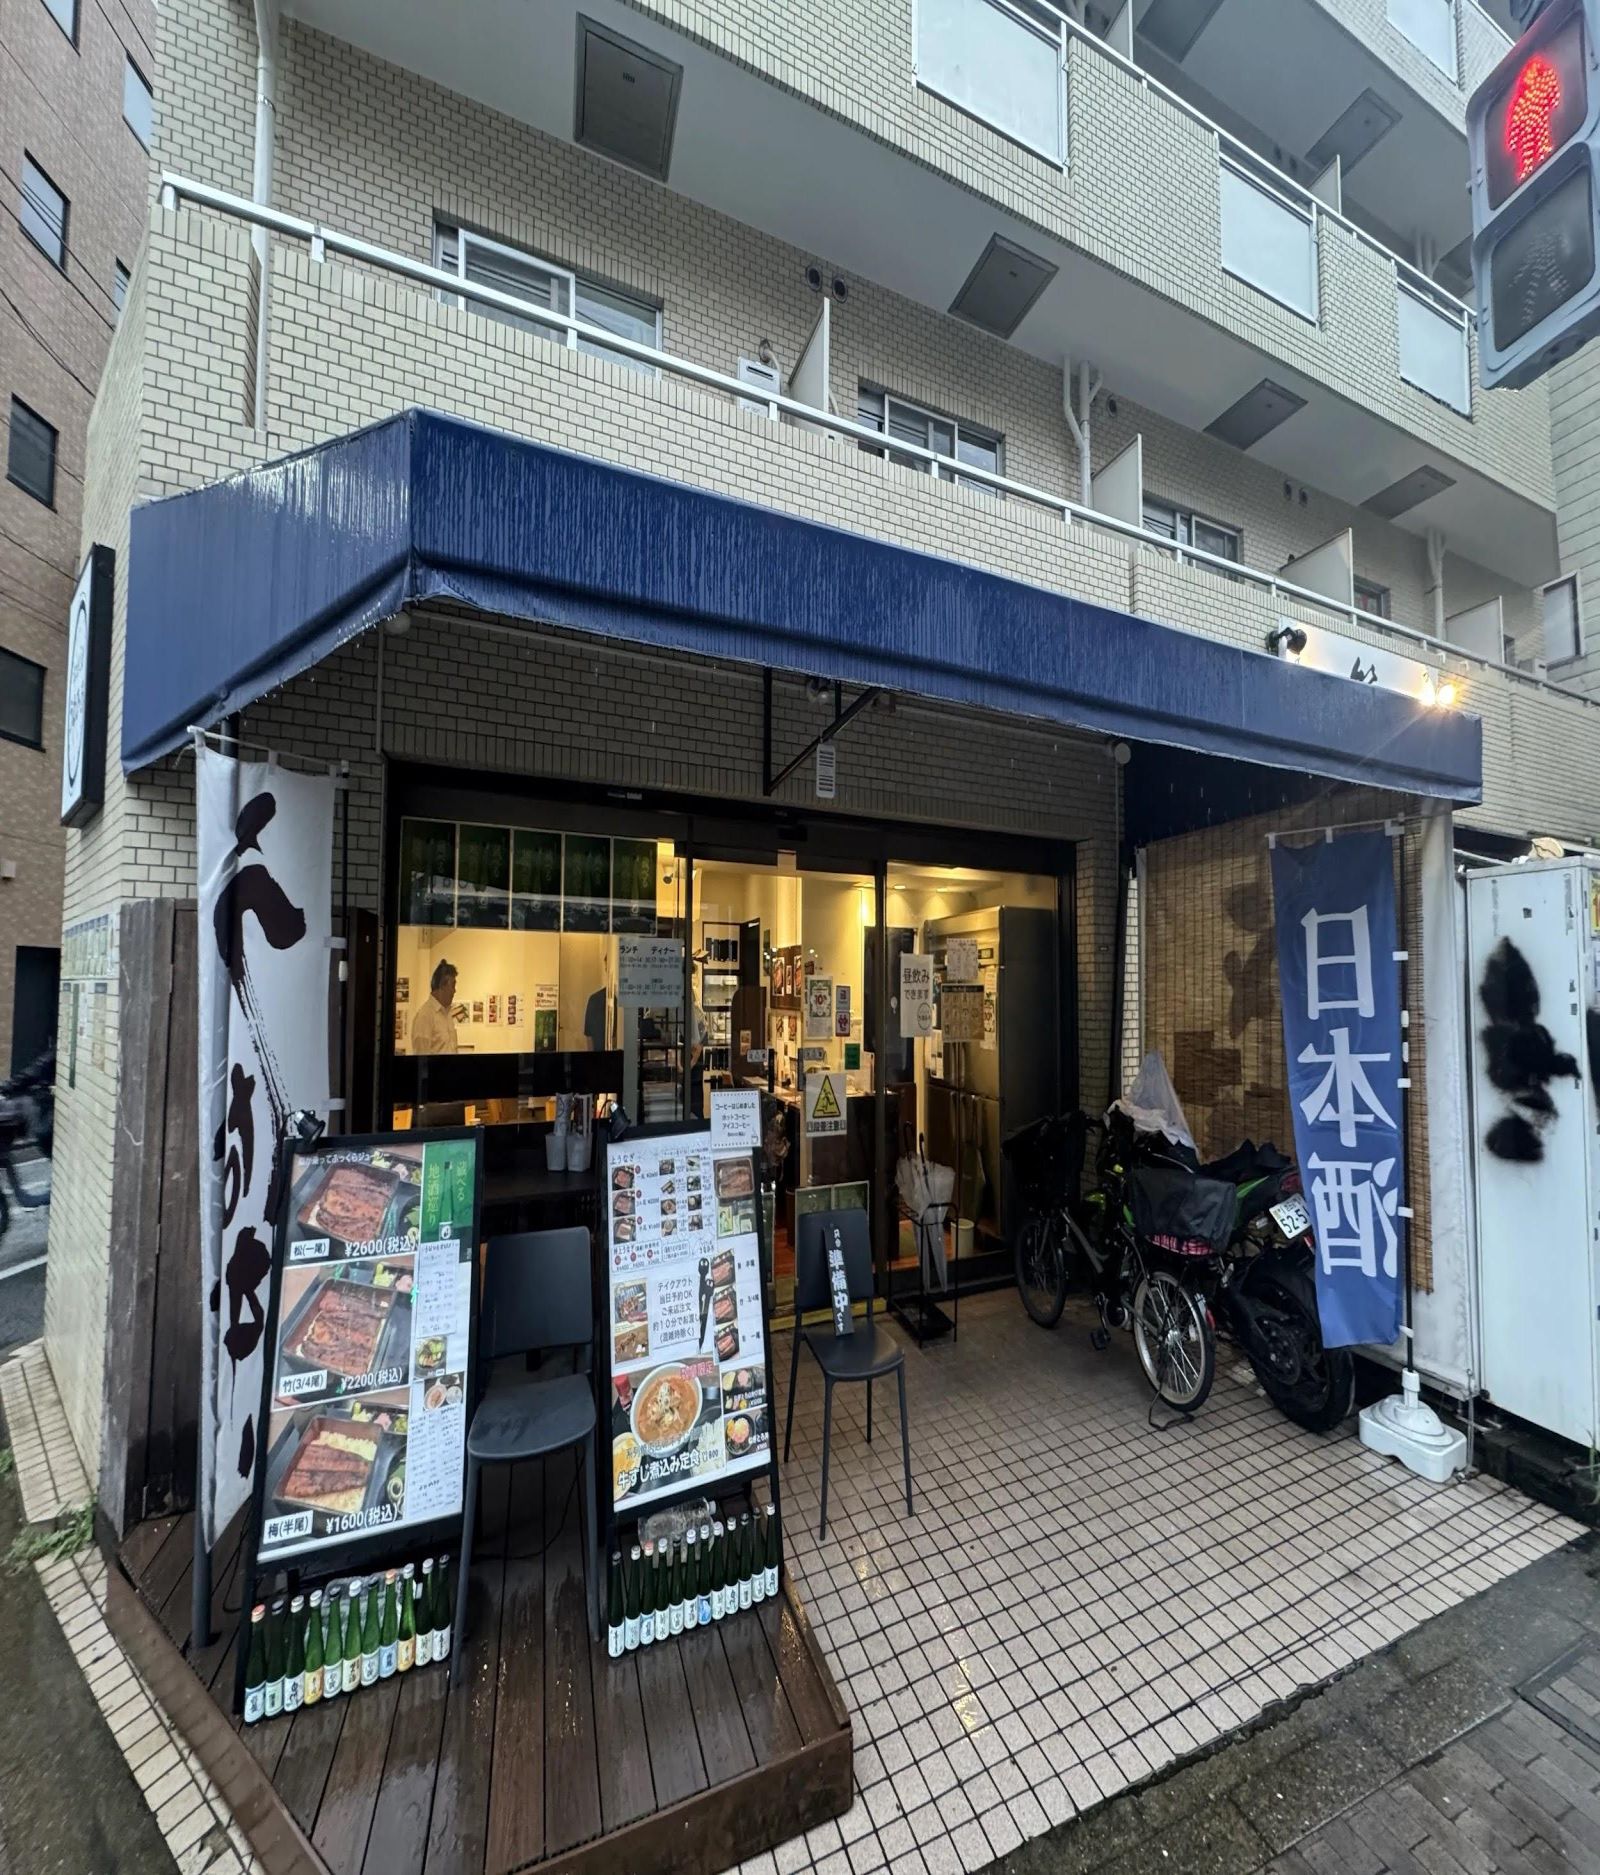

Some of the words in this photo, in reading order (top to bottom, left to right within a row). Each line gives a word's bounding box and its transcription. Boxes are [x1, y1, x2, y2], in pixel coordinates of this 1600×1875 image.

[620, 945, 638, 953] ランチ
[651, 945, 675, 954] ディナー
[903, 968, 929, 984] 昼飲み
[904, 989, 929, 1000] できます
[715, 1102, 756, 1110] コーヒーはじめました
[1280, 1205, 1310, 1233] 52-5
[294, 1242, 327, 1256] 松(一尾)
[658, 1279, 693, 1292] テイクアウト
[660, 1290, 693, 1304] 当日予約OK
[662, 1302, 691, 1316] ご来店注文
[283, 1374, 324, 1392] 竹(3/4尾)
[341, 1367, 403, 1390] ¥2200(税込)
[618, 1449, 700, 1490] 牛すじ煮込み定食
[268, 1517, 309, 1538] 梅(半尾)
[326, 1505, 398, 1534] ¥1600(税込)
